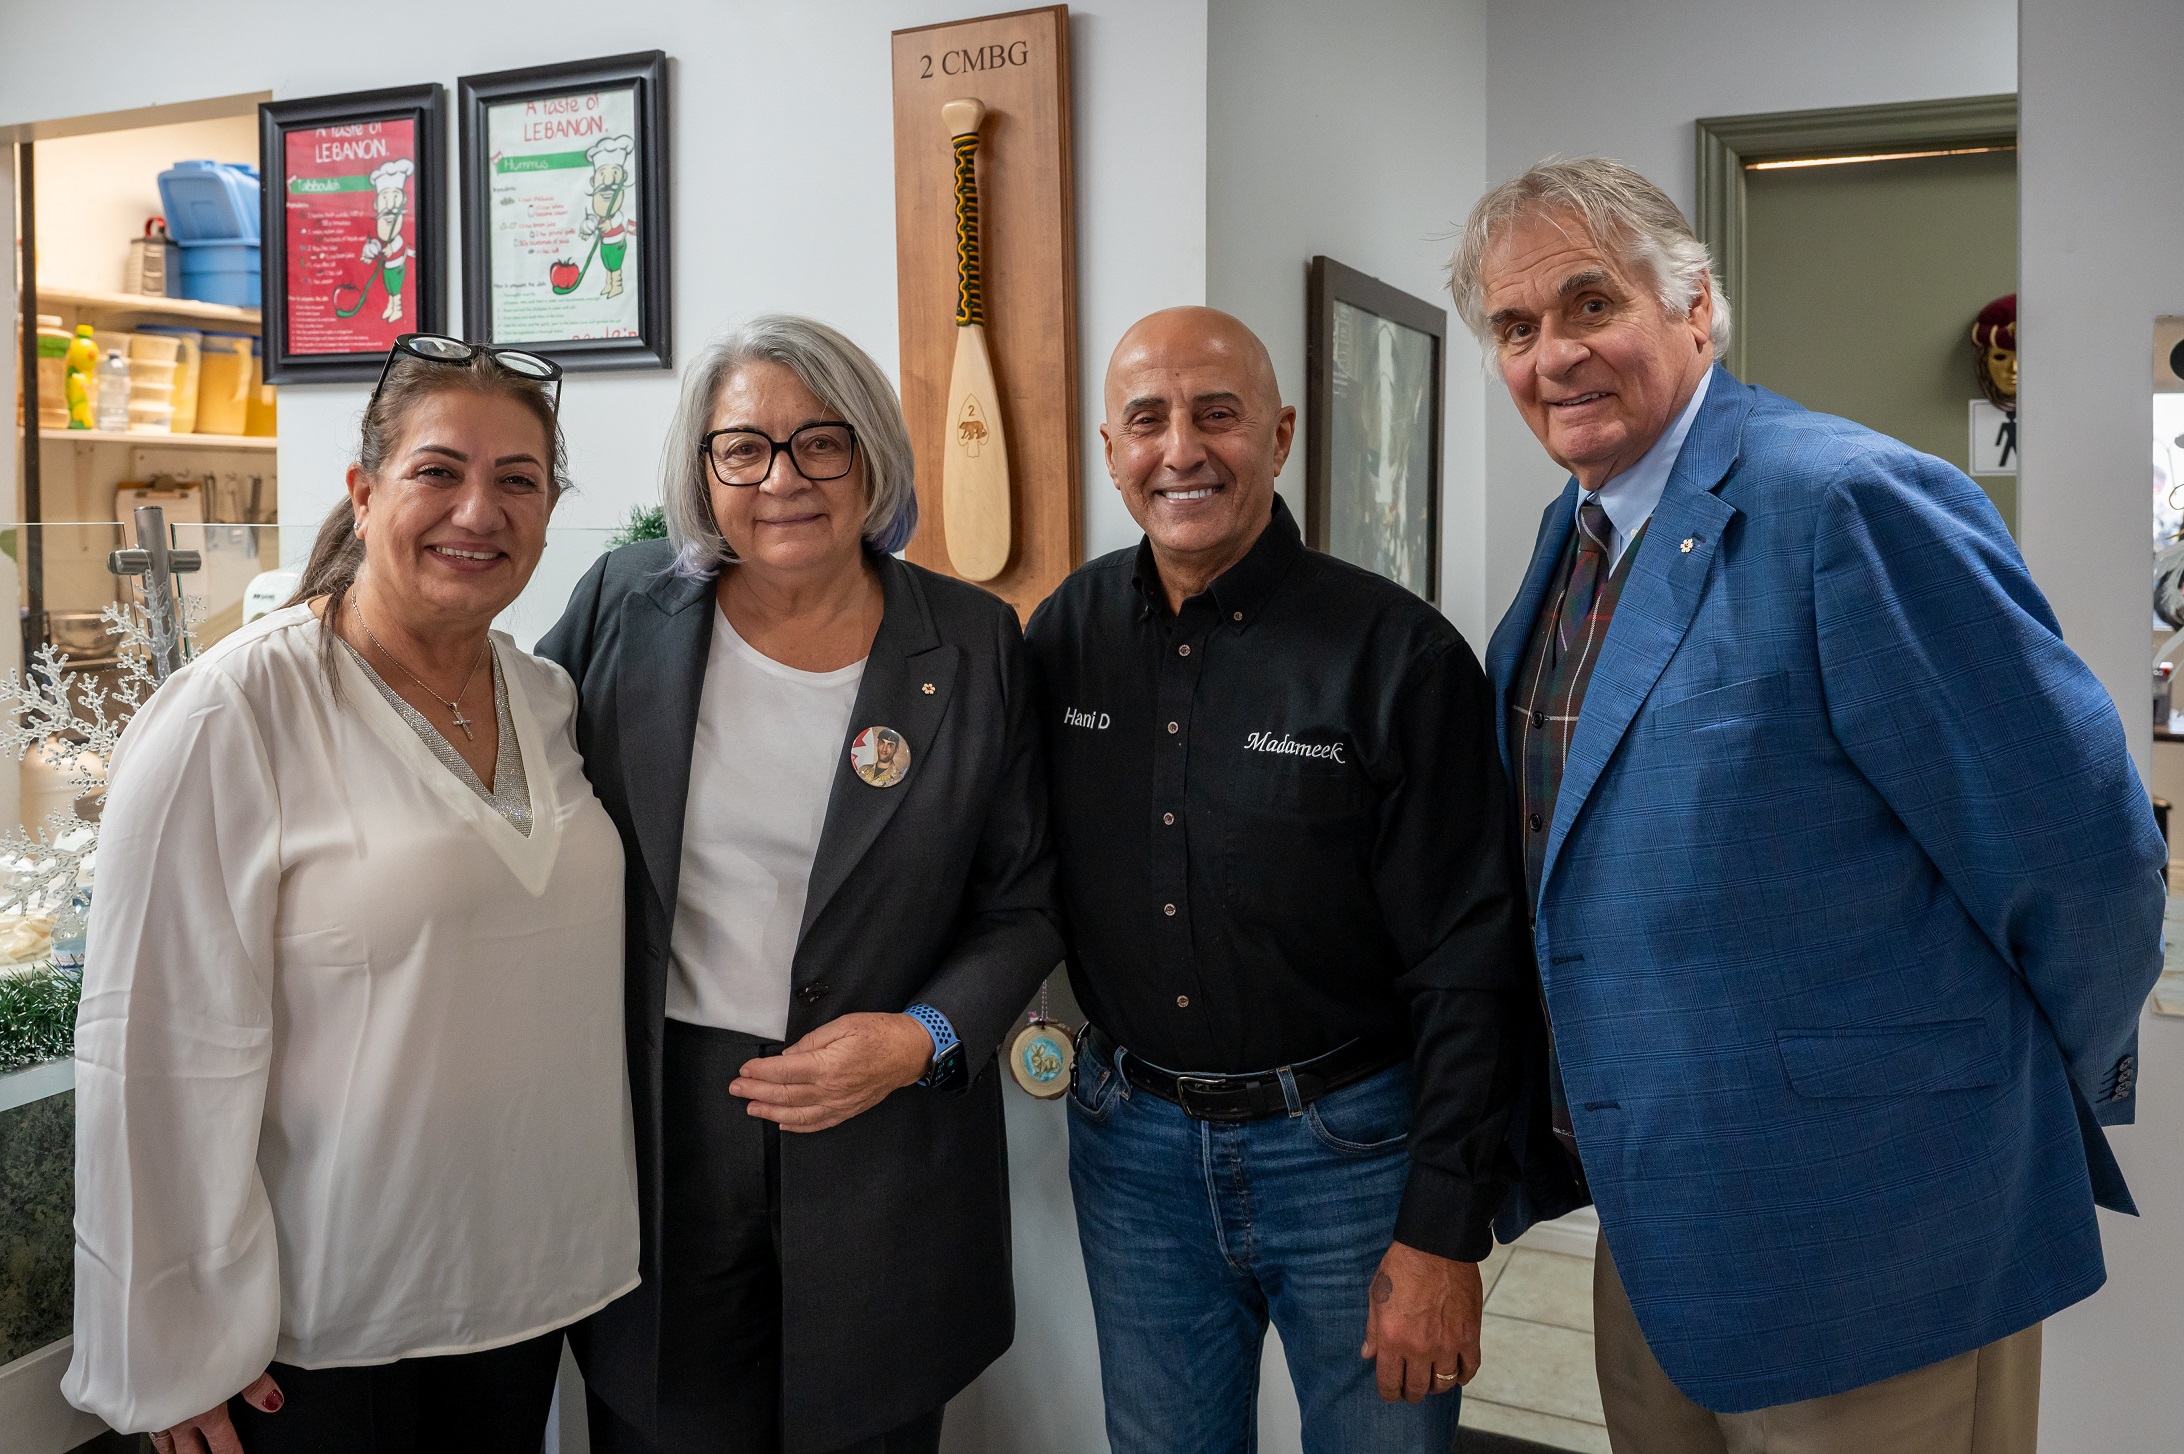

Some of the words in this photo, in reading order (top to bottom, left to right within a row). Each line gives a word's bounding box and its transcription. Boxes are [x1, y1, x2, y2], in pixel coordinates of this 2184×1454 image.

[920, 54, 934, 79] 2
[942, 40, 1029, 75] CMBG
[504, 158, 549, 171] Hummus
[968, 404, 976, 417] 2
[1063, 706, 1097, 729] Hani
[1098, 713, 1111, 730] D
[1243, 731, 1346, 765] Madameek
